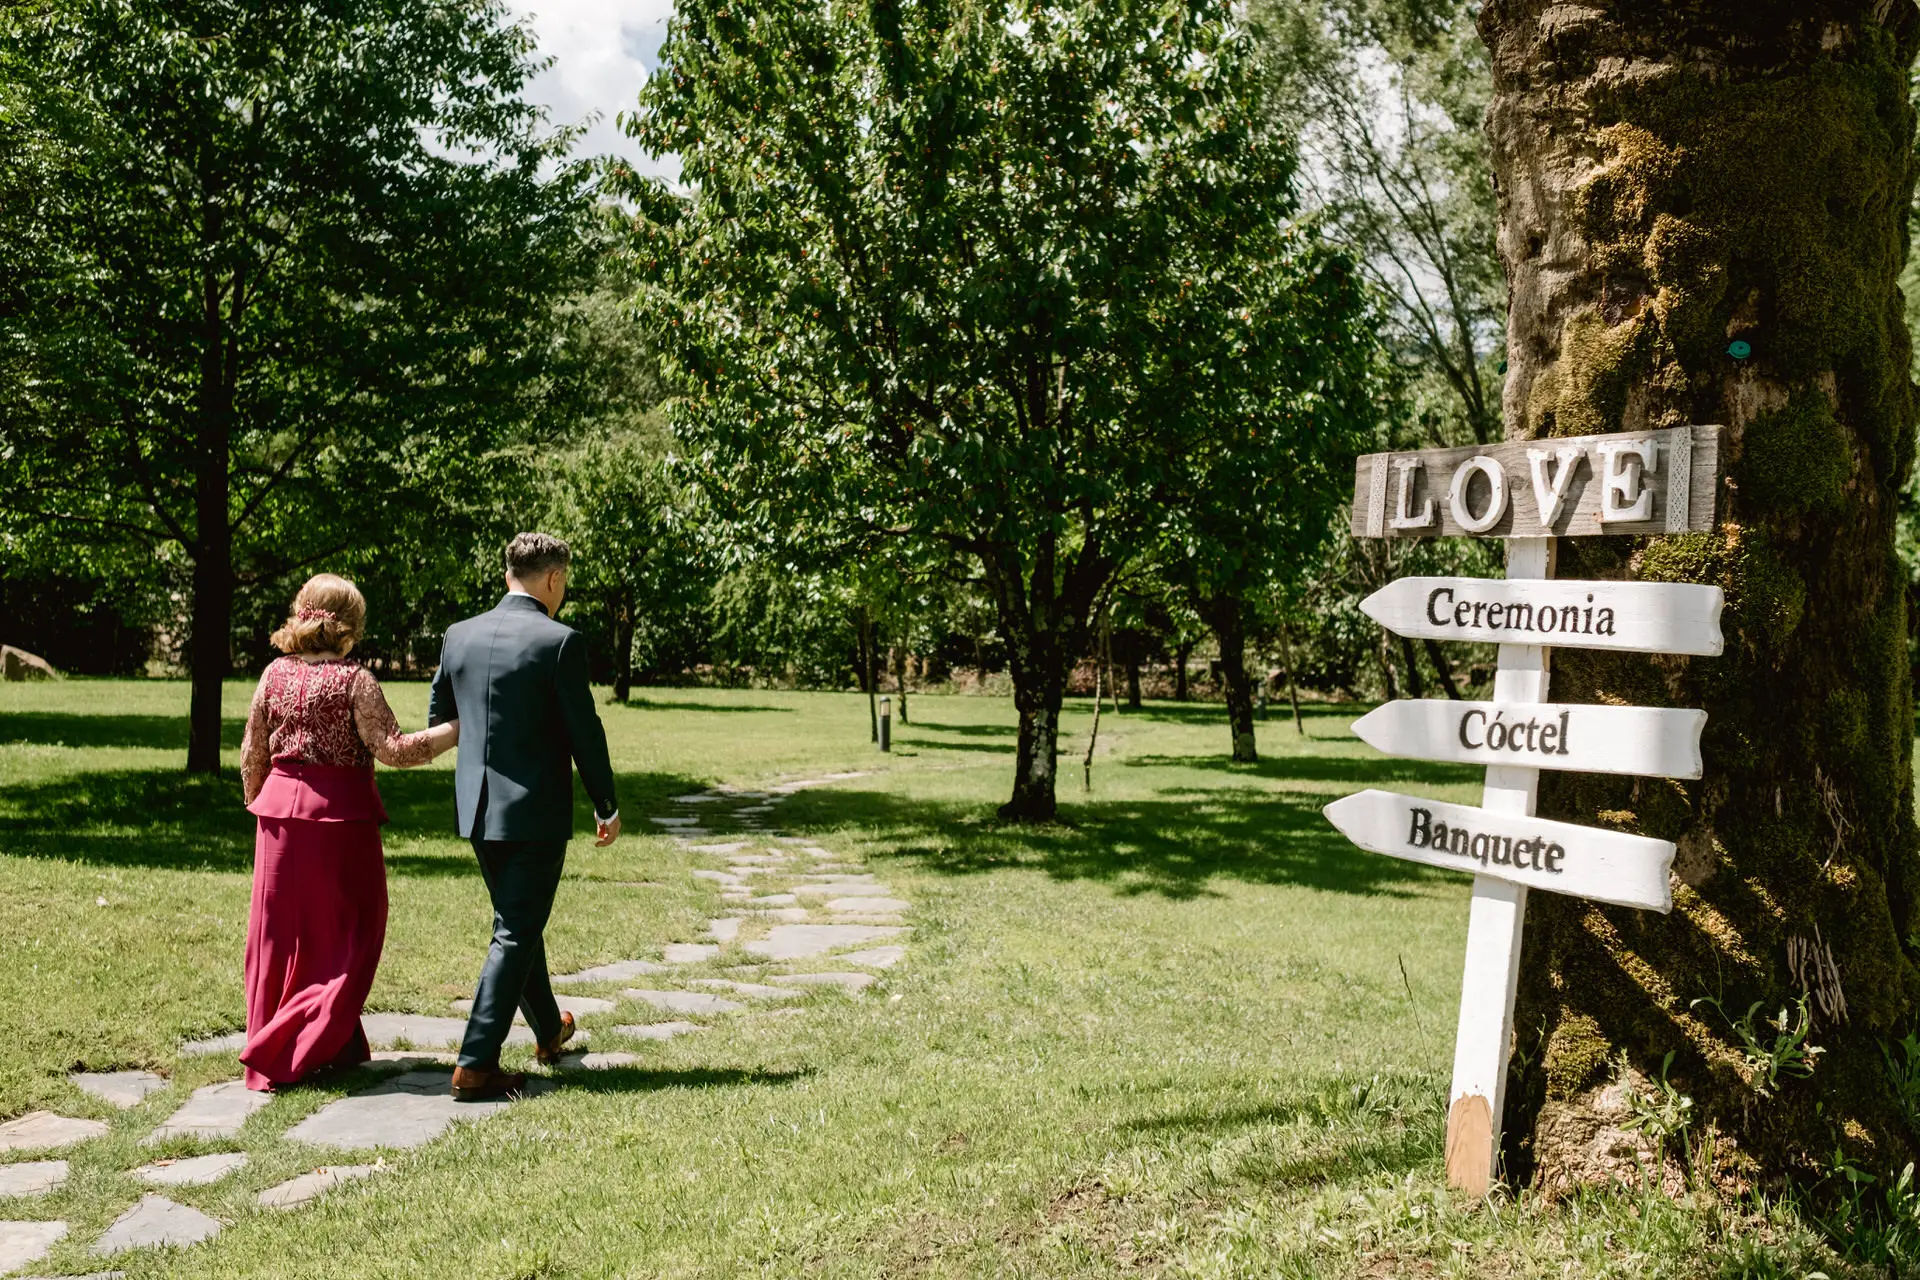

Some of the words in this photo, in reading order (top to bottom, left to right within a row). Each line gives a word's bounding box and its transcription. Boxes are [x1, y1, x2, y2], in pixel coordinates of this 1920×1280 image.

[1389, 439, 1658, 533] LOVE
[1427, 587, 1616, 636] Ceremonia
[1459, 709, 1570, 755] Cóctel
[1407, 808, 1565, 874] Banquete
